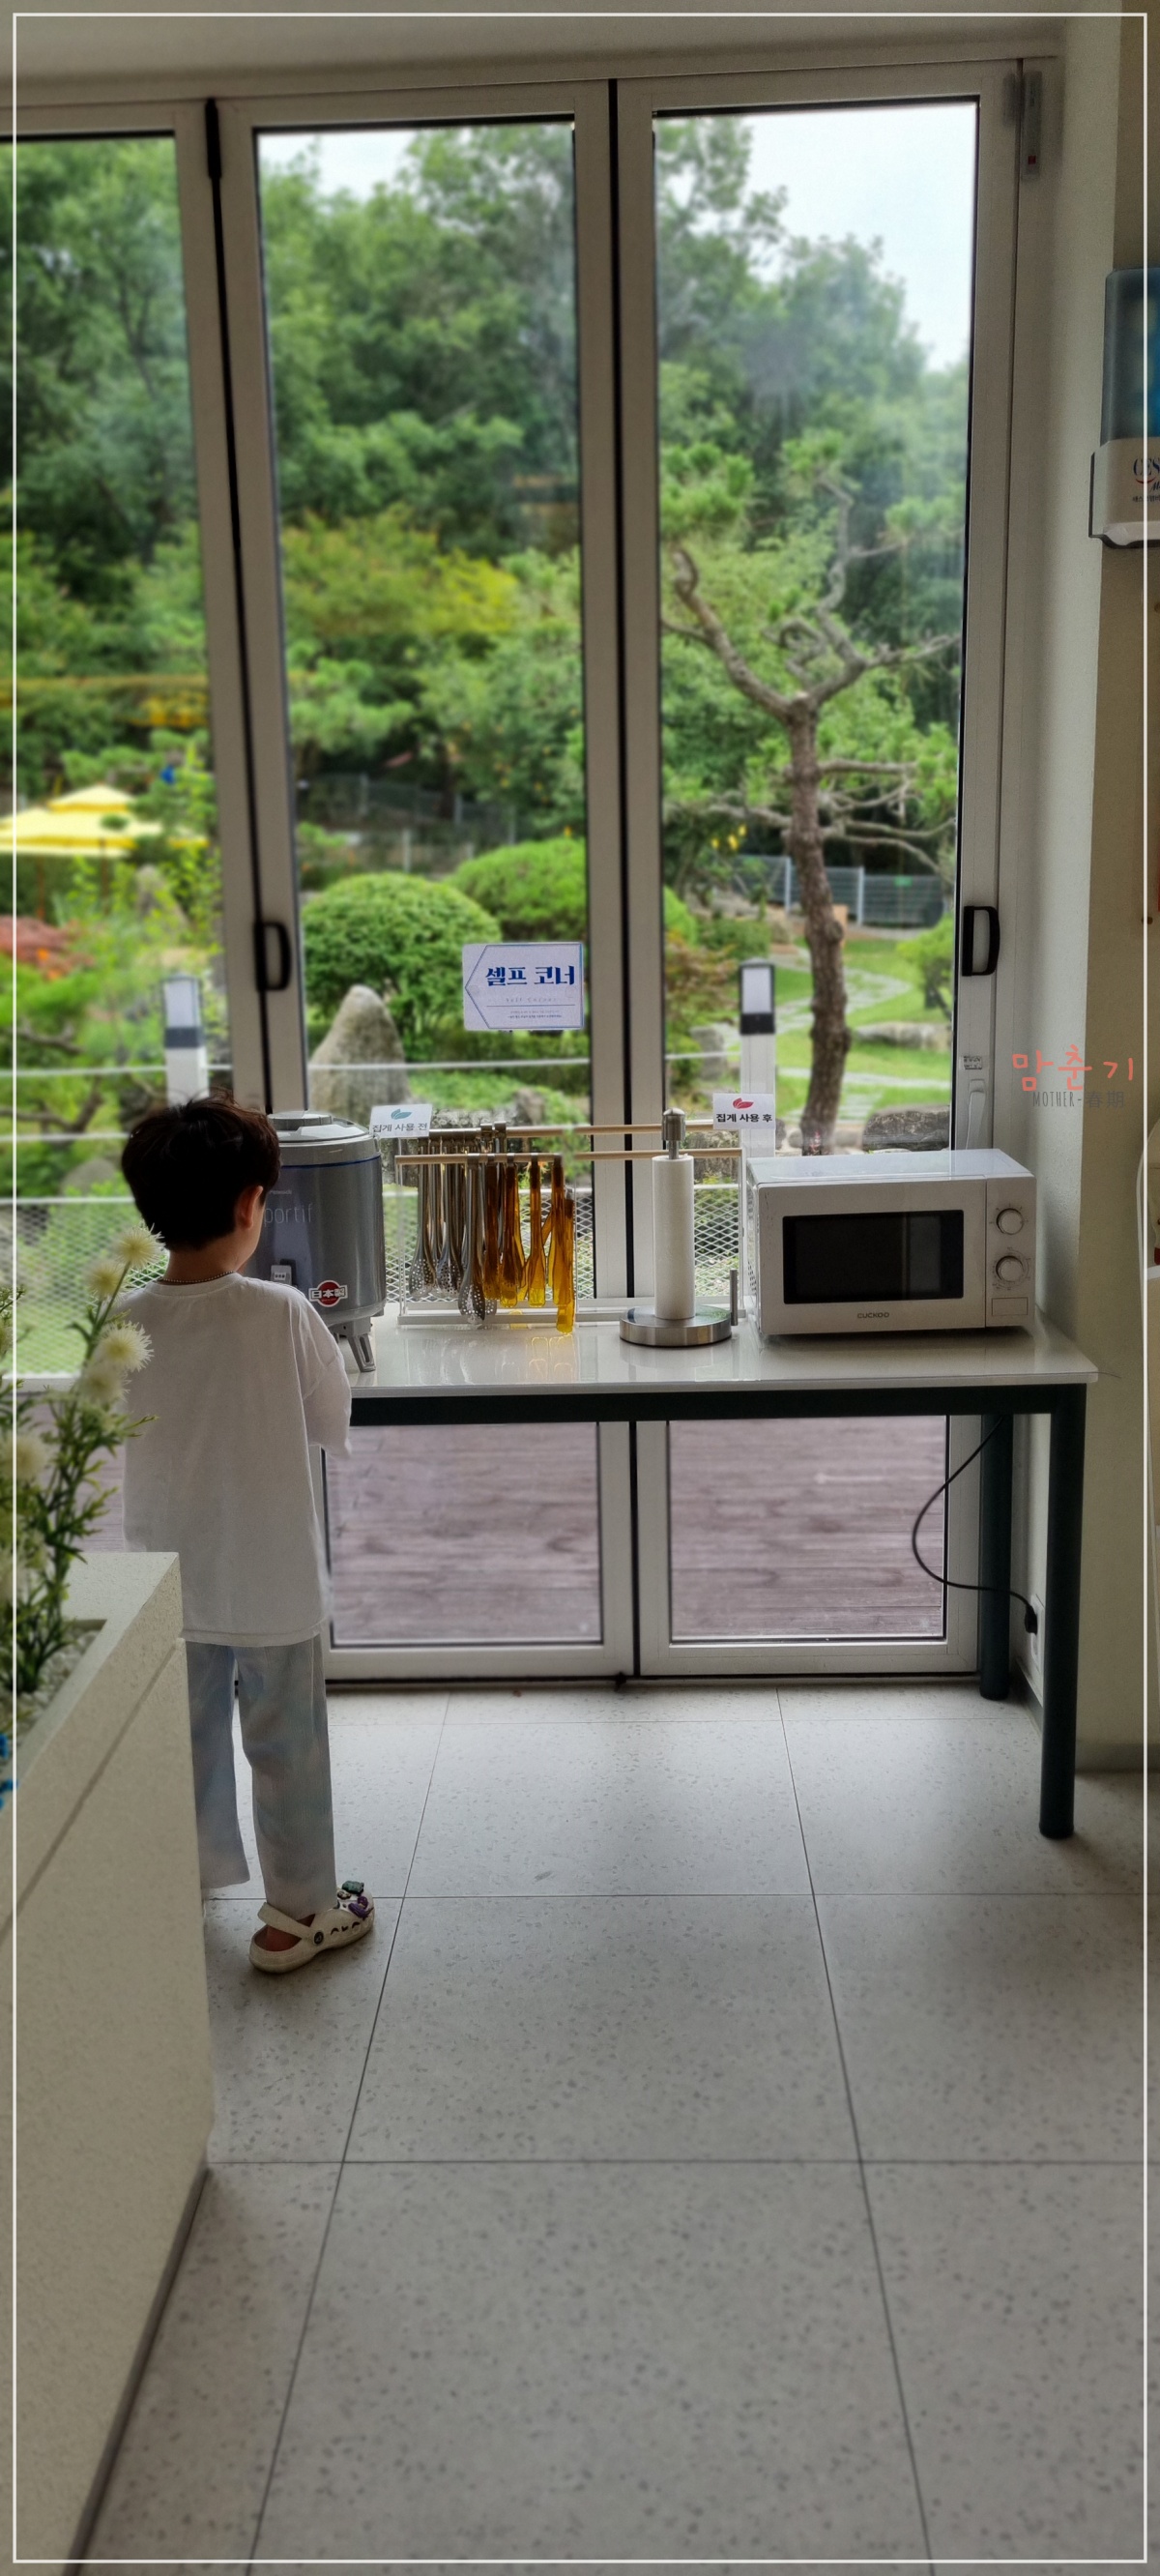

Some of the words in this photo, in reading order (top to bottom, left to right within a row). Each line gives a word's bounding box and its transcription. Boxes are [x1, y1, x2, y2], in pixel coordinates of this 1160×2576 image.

[485, 966, 528, 986] 셀프
[534, 965, 575, 985] 코너
[715, 1113, 737, 1123] 집게
[740, 1113, 760, 1123] 사용
[762, 1113, 773, 1123] 후
[372, 1124, 392, 1132] 집게
[394, 1123, 415, 1131] 사용
[418, 1122, 428, 1131] 전
